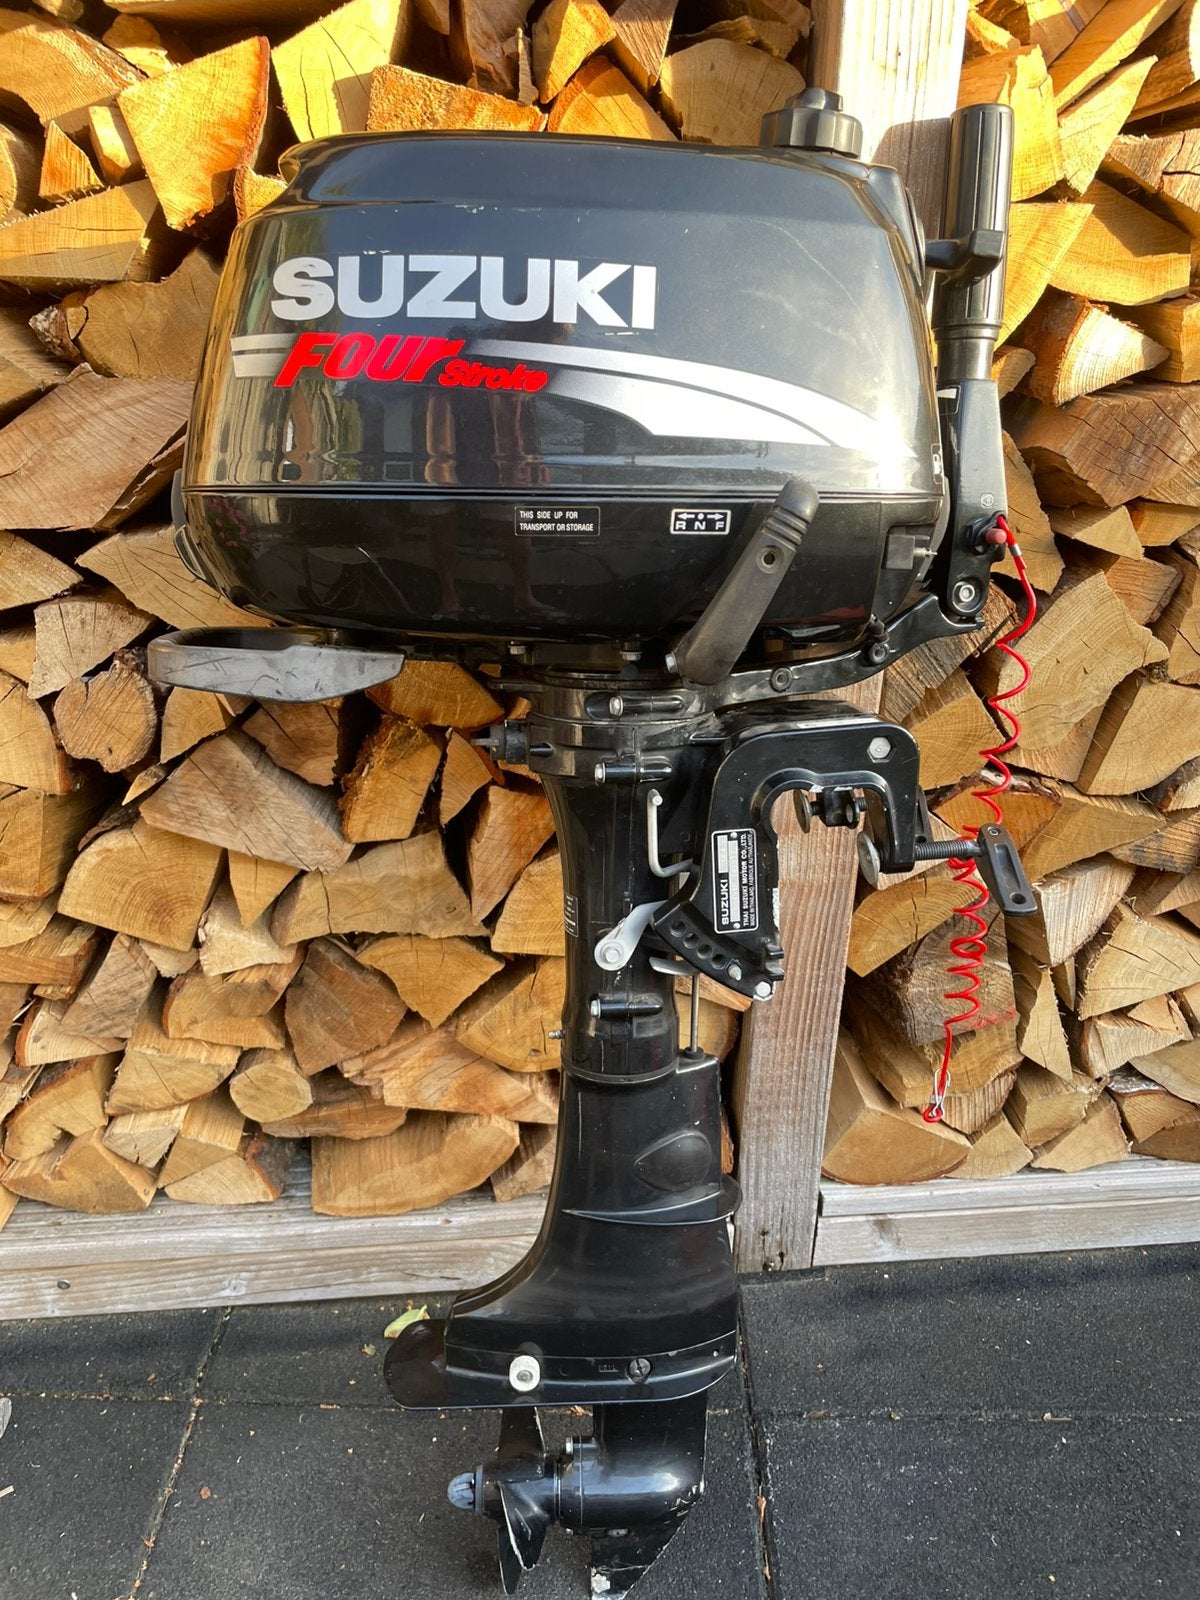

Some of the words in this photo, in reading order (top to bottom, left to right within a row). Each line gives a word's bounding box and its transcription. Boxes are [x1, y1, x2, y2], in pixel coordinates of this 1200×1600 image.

[271, 254, 657, 330] SUZUKI
[438, 359, 549, 392] Stroke
[520, 511, 534, 519] THIS
[537, 511, 551, 519] SIDE
[554, 511, 563, 519] UP
[566, 511, 578, 519] FOR
[675, 521, 686, 530] R
[694, 521, 706, 530] N
[715, 521, 725, 530] F
[520, 523, 555, 531] TRANSPORT
[720, 879, 729, 925] SUZUKI
